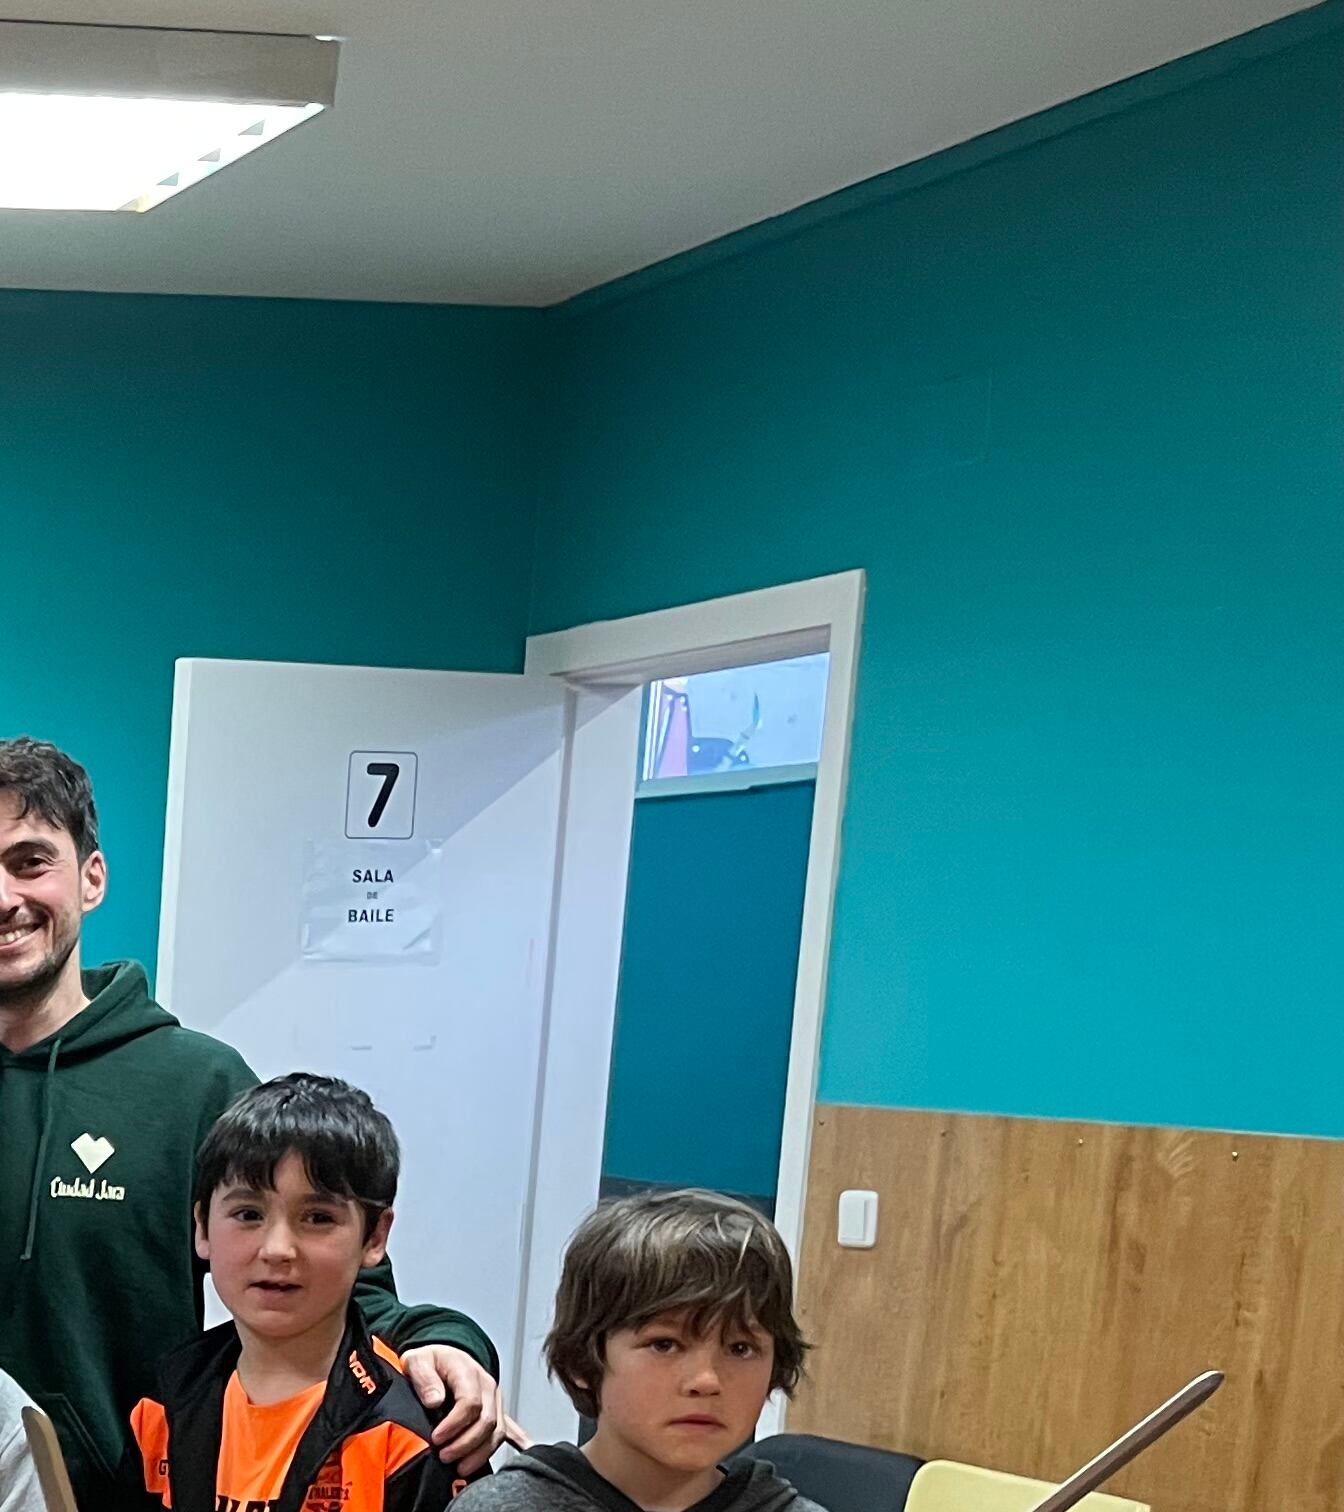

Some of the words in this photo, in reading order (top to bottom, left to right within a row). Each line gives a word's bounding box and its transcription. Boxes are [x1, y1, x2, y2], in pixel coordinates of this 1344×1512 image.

[366, 762, 400, 828] 7
[352, 869, 394, 883] SALA
[366, 891, 378, 900] DE
[348, 908, 395, 923] BAILE
[50, 1176, 95, 1198] Ciudad
